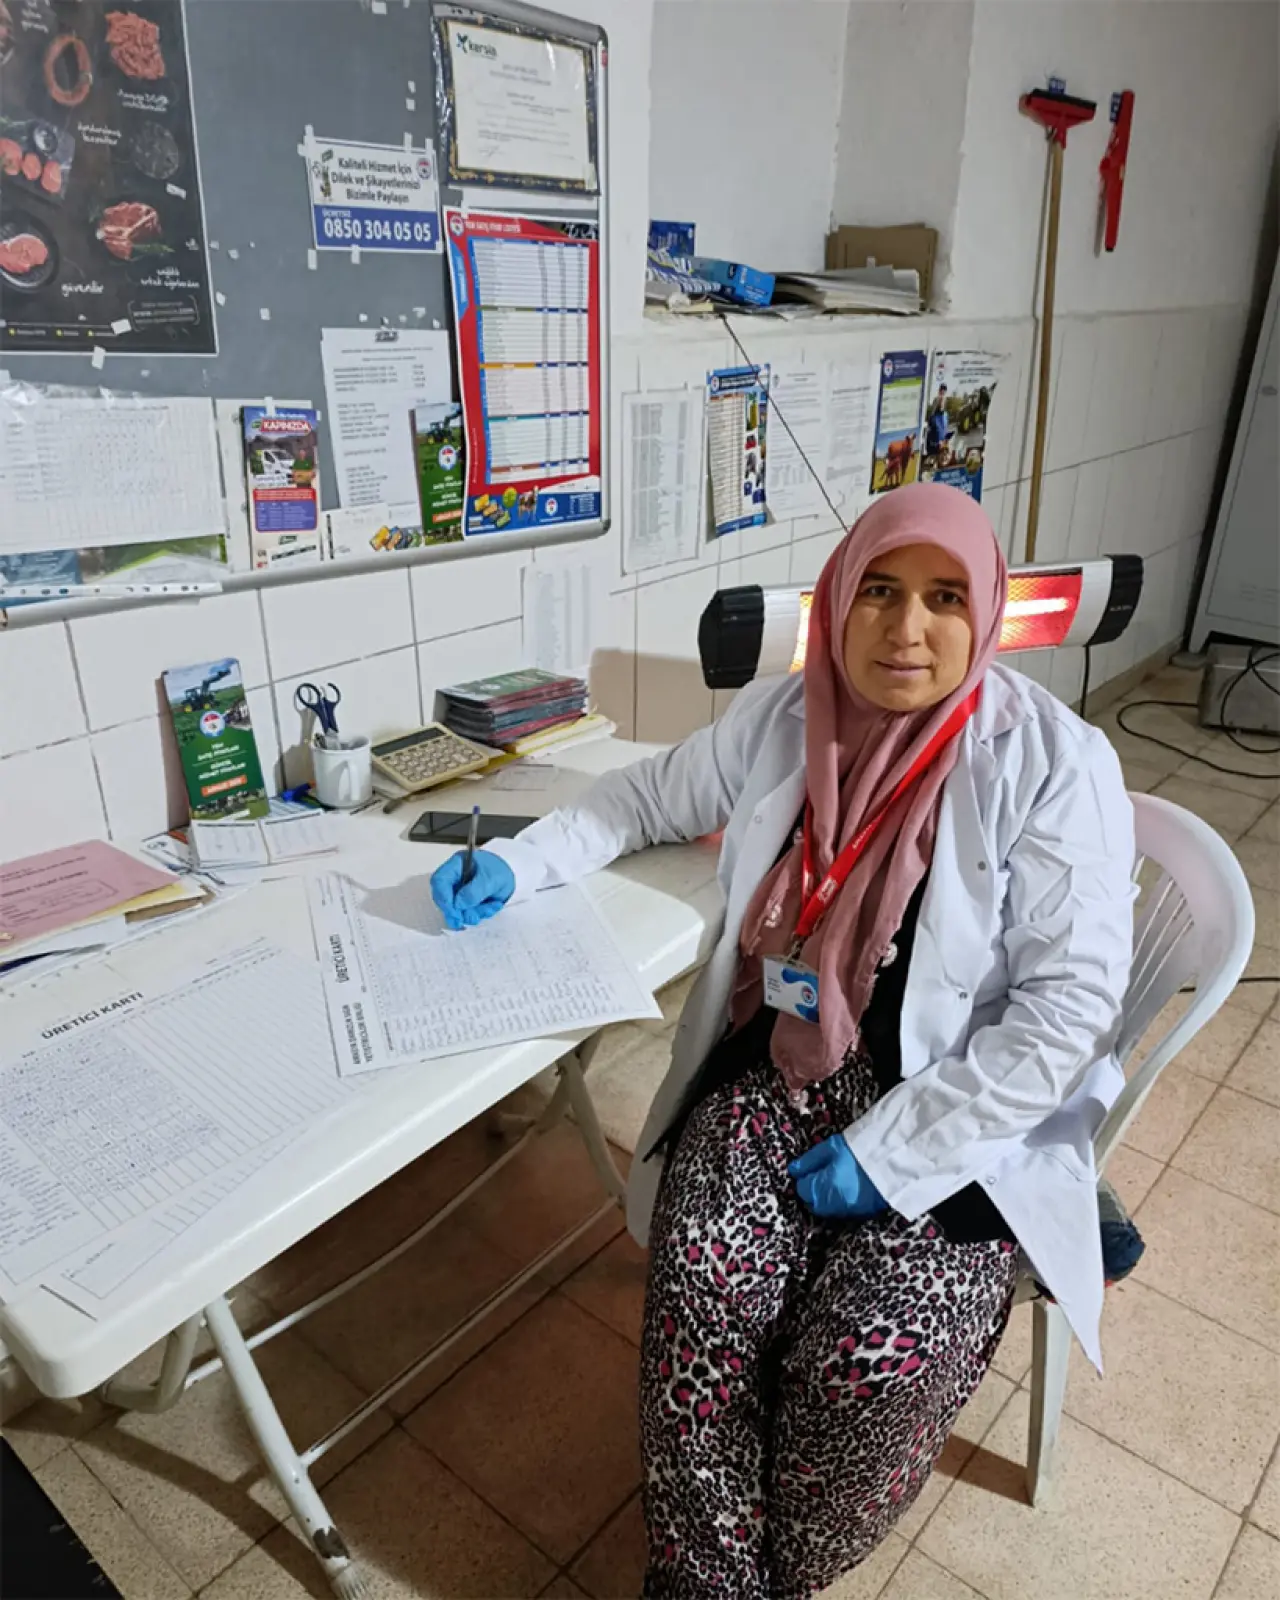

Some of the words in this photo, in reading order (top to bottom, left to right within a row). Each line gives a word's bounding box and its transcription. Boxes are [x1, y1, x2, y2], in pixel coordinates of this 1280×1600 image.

[468, 40, 497, 57] kersia
[338, 157, 367, 170] Kaliteli
[368, 161, 396, 173] Hizmet
[398, 160, 412, 176] İçin
[330, 171, 353, 184] Dilek
[355, 175, 365, 186] ve
[365, 174, 421, 190] Şikayetlerinizi
[346, 188, 377, 201] Bizimle
[377, 190, 410, 205] Paylaşın
[324, 217, 362, 239] 0850
[364, 219, 392, 240] 304
[393, 220, 412, 241] 05
[413, 221, 432, 242] 05
[263, 419, 309, 431] KAPINIZDA
[329, 934, 343, 954] KARTI
[335, 954, 350, 983] ÜRETİCİ
[41, 1010, 99, 1040] ÜRETİCİ
[100, 991, 144, 1015] KARTI
